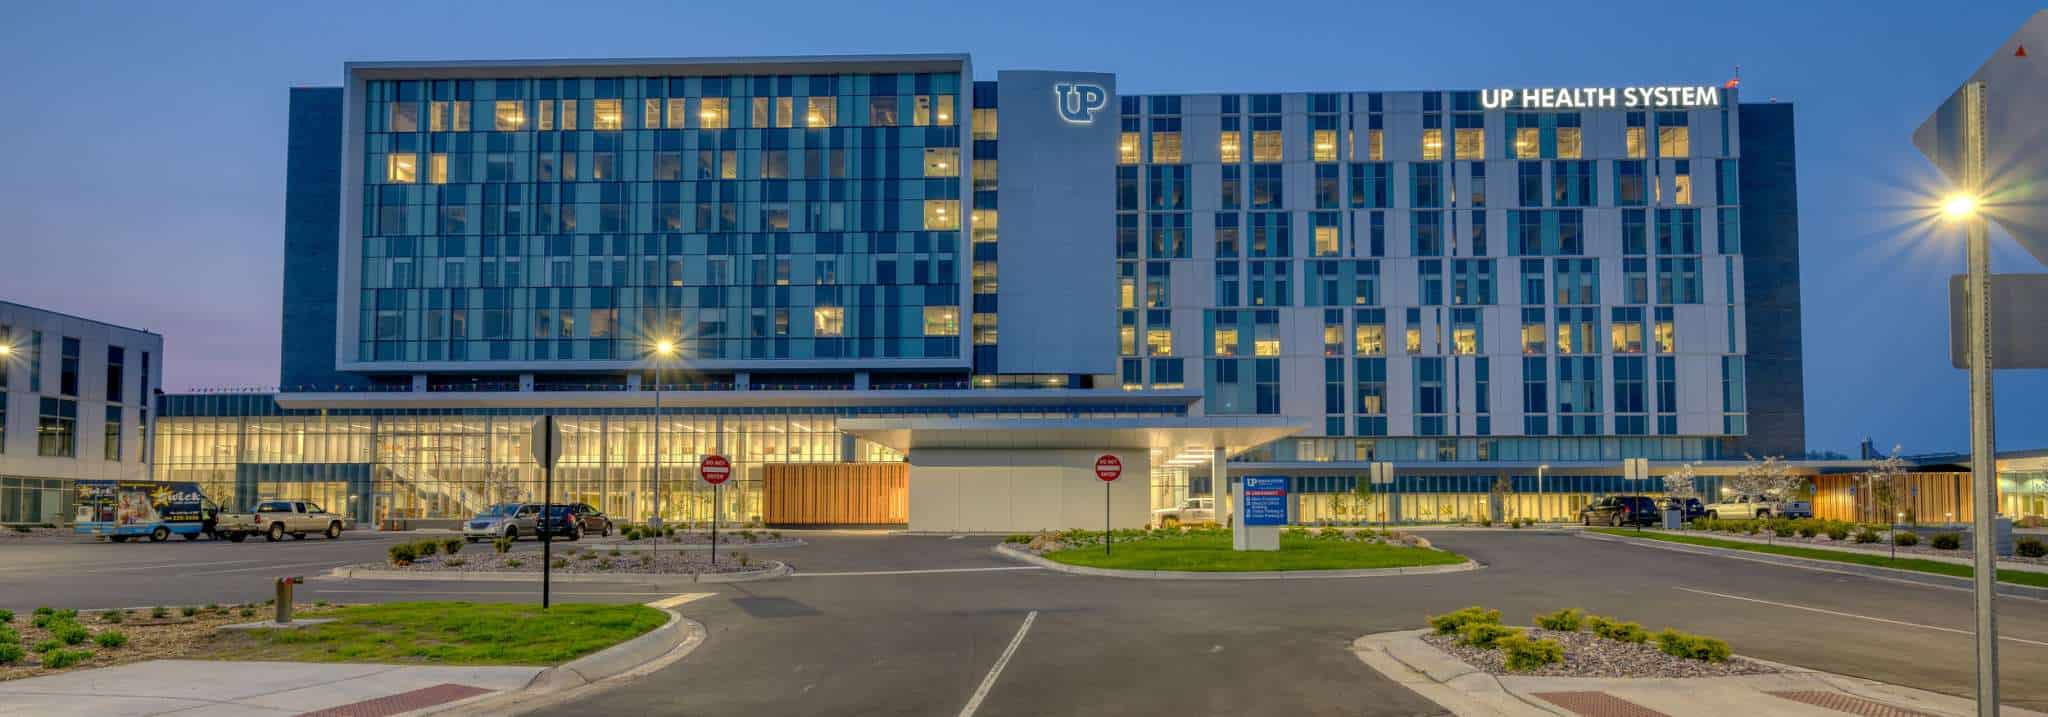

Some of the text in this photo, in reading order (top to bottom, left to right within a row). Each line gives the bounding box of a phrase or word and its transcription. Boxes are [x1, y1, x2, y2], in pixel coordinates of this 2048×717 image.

[1055, 83, 1106, 124] UP
[1482, 86, 1719, 108] UP HEALTH SYSTEM
